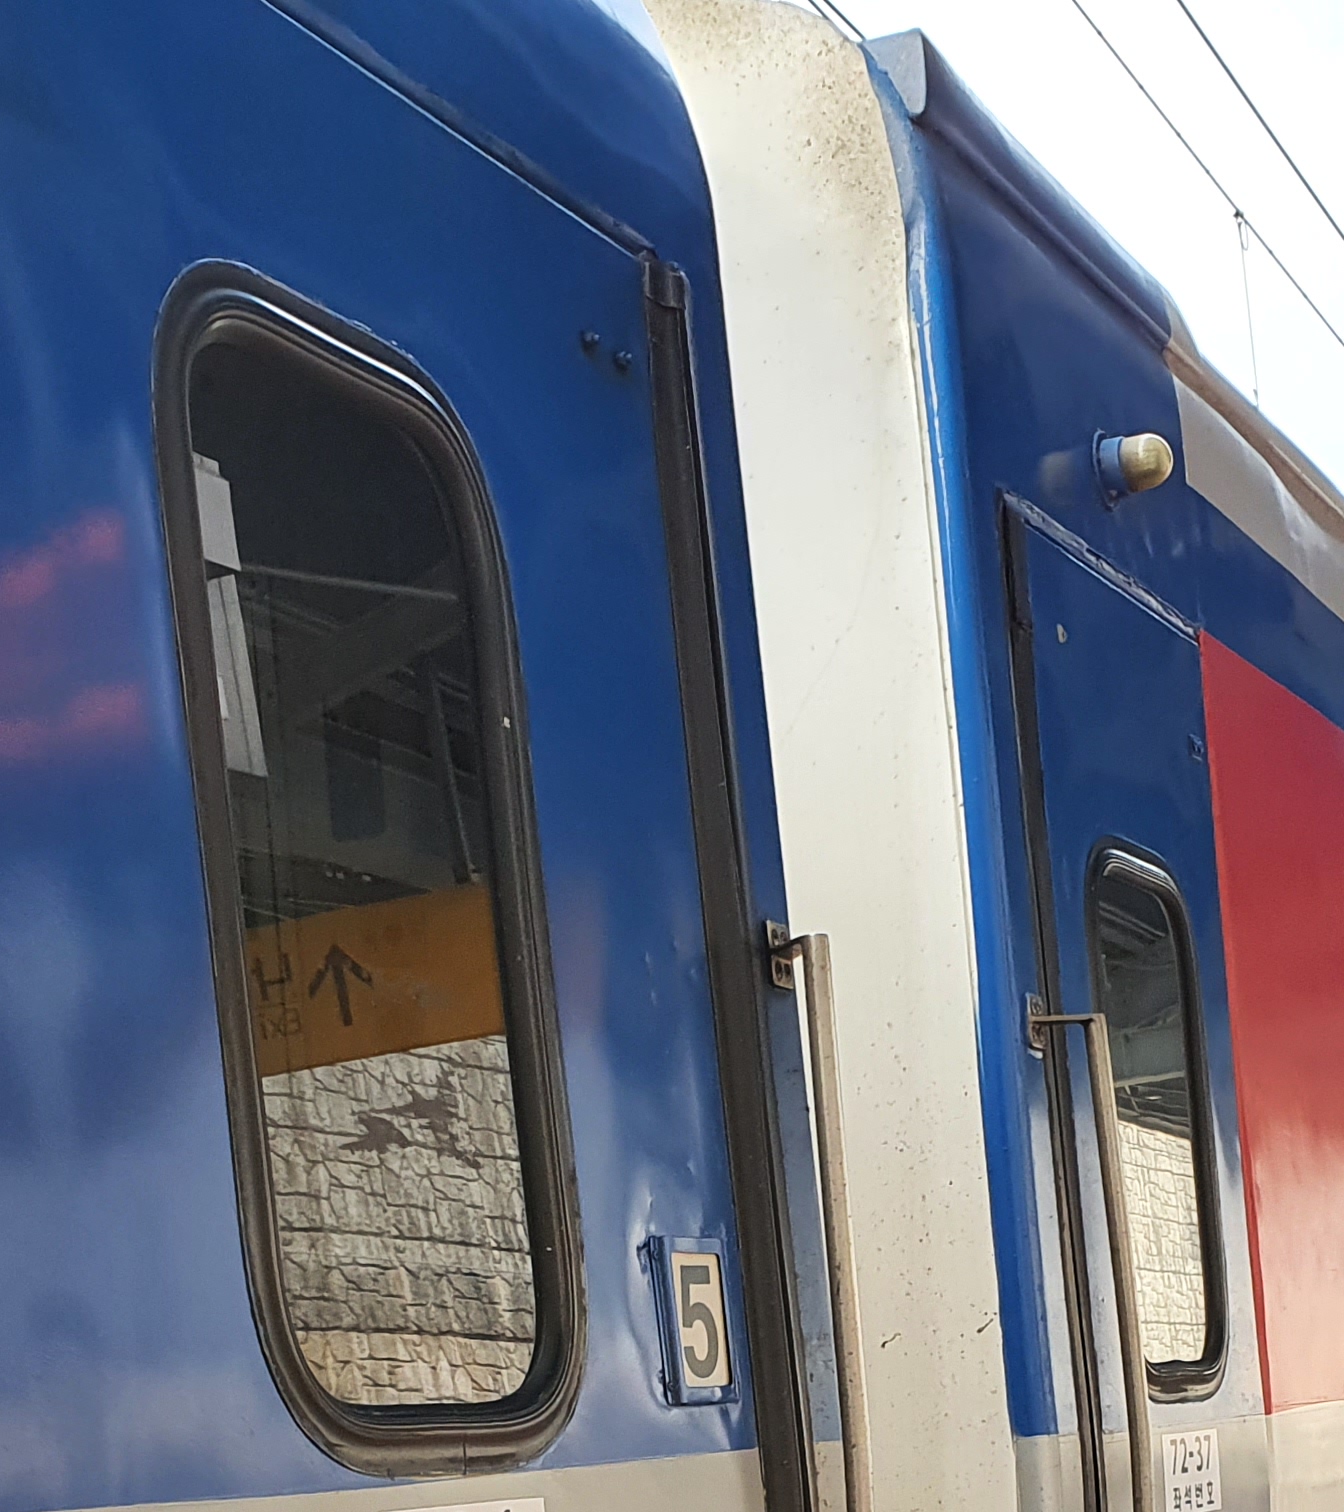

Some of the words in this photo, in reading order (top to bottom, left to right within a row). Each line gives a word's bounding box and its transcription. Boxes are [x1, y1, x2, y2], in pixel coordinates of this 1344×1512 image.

[679, 1264, 719, 1378] 5
[1170, 1435, 1212, 1475] 72-37
[1173, 1481, 1215, 1512] 좌석번호
